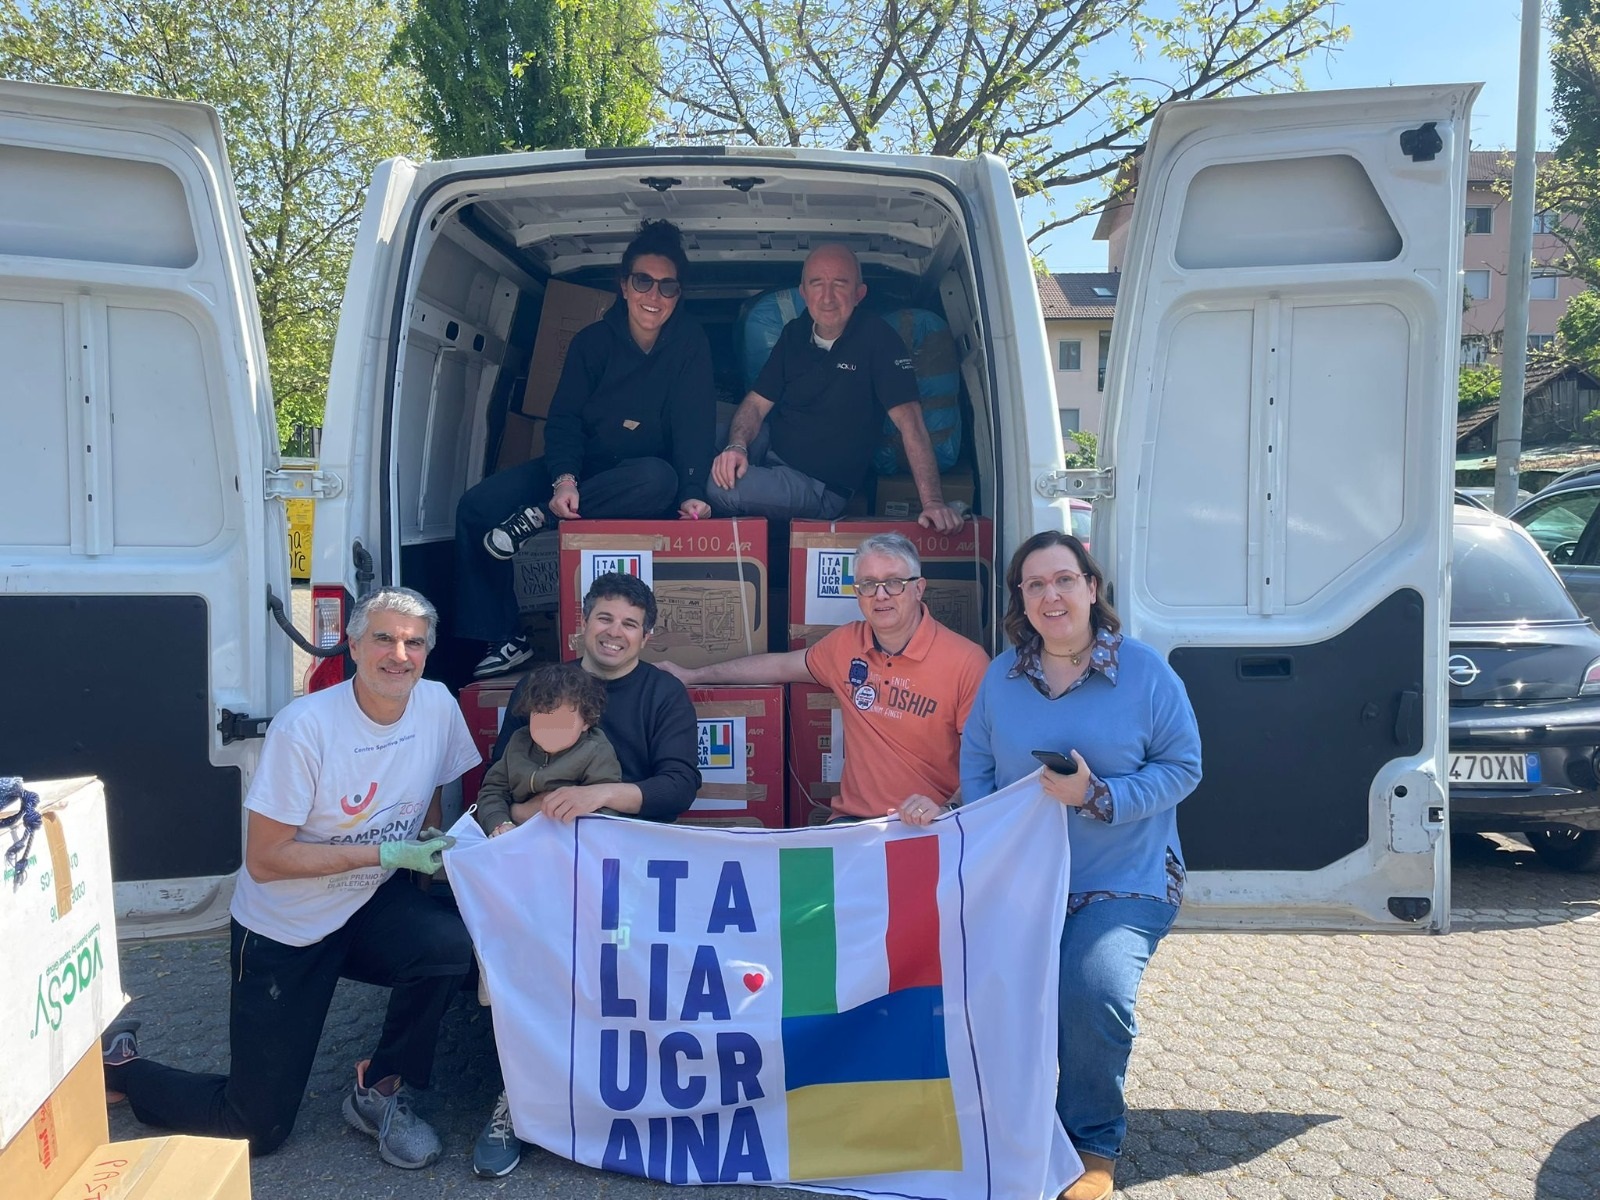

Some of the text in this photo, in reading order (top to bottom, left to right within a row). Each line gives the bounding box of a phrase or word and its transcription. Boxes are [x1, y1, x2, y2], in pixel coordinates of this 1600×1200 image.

[673, 536, 721, 552] 4100
[915, 536, 950, 552] 100
[596, 559, 616, 570] ITA
[821, 556, 841, 567] ITA
[821, 576, 840, 586] UCR
[820, 585, 840, 595] AINA
[1450, 755, 1526, 780] 470XN
[601, 858, 757, 934] ITA
[600, 943, 731, 1021] LIA
[599, 1029, 766, 1112] UCR
[600, 1106, 772, 1184] AINA
